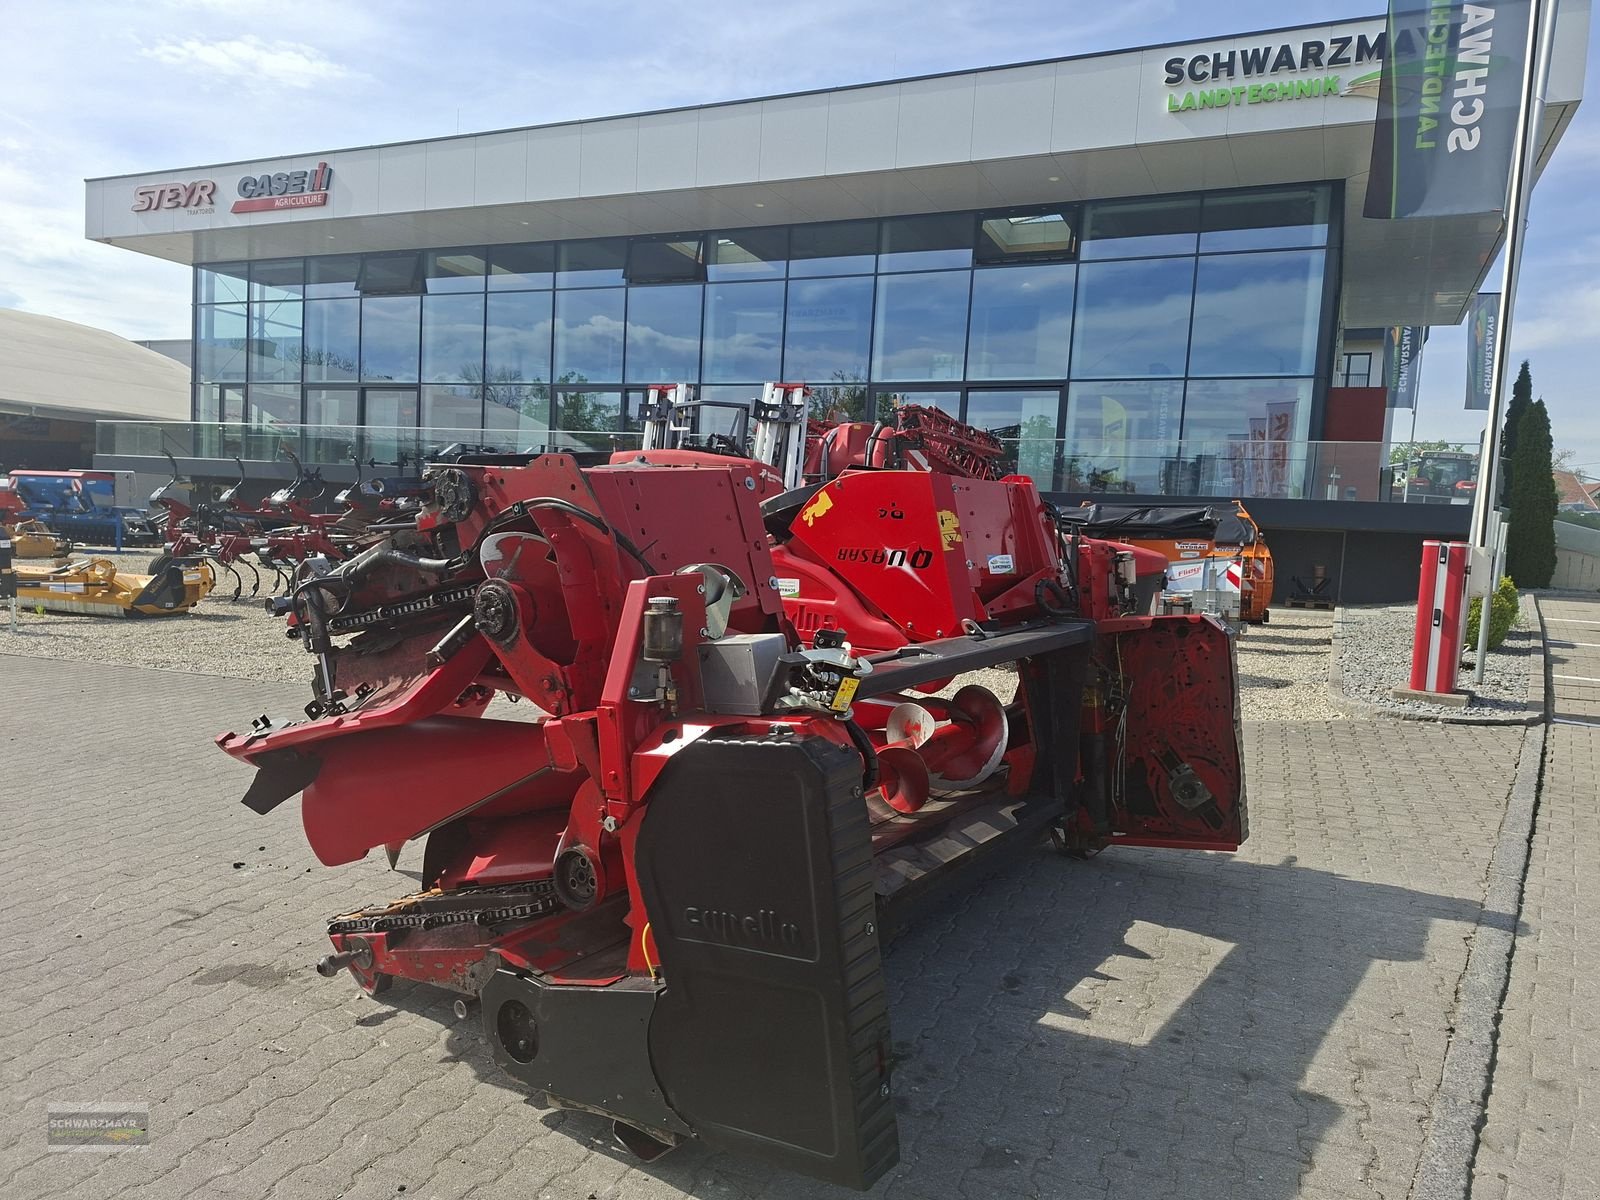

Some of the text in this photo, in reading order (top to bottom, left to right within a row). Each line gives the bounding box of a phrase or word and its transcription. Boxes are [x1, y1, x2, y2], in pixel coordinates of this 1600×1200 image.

[1168, 74, 1341, 113] LANDTECHNIK
[131, 179, 217, 212] STEYR
[237, 170, 308, 199] CASE
[274, 193, 322, 208] AGRICULTURE
[836, 545, 934, 570] QUASAR
